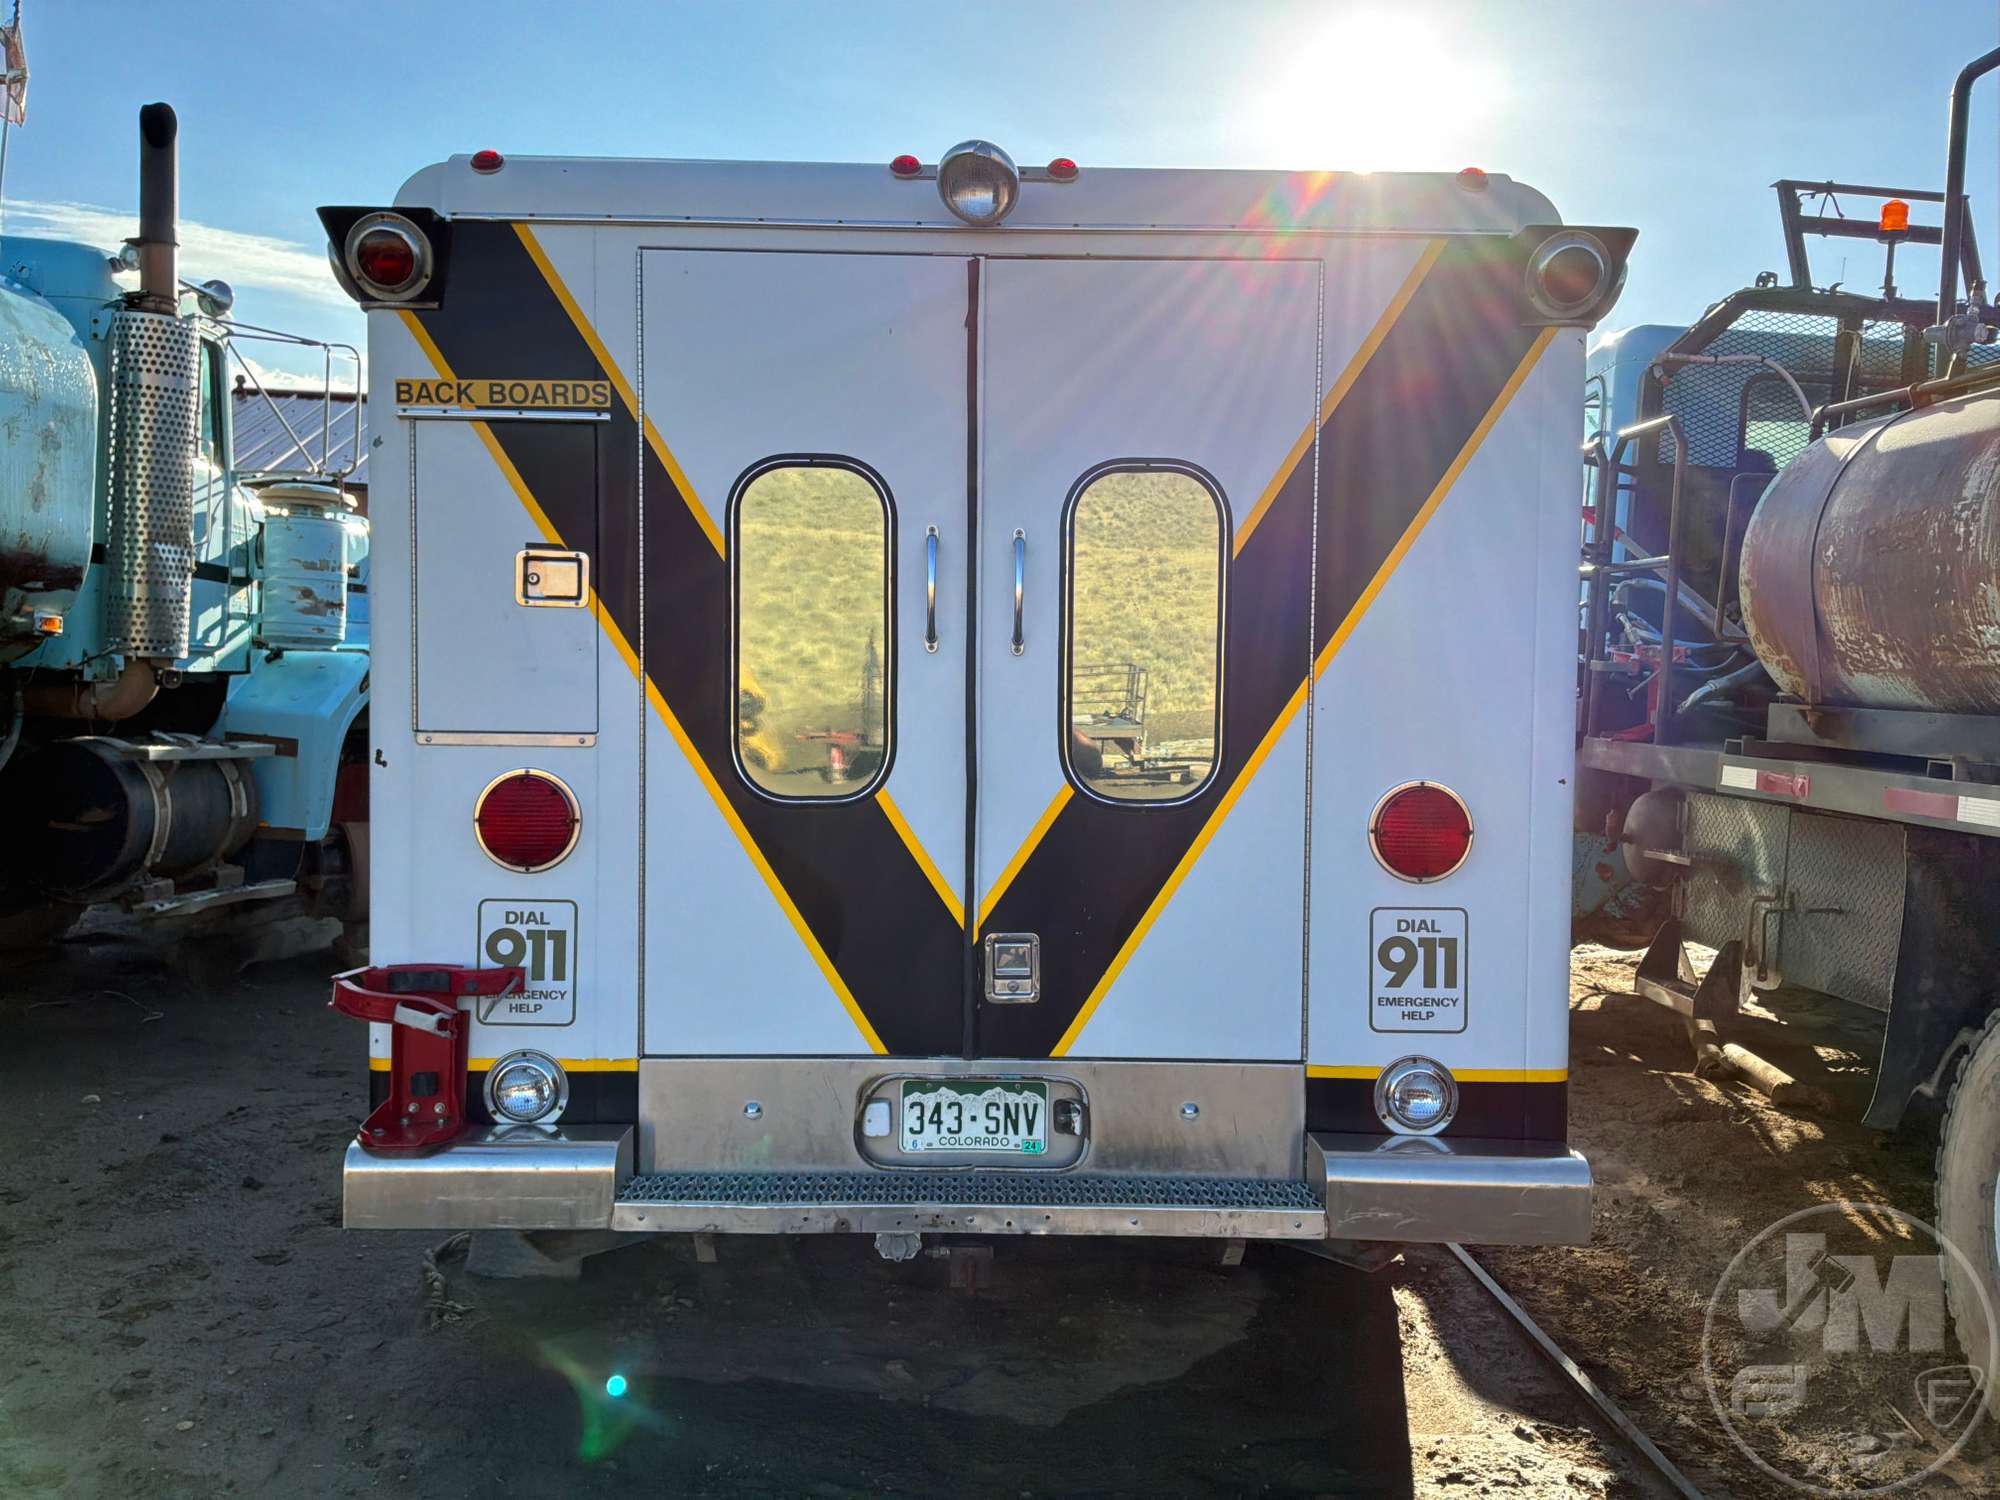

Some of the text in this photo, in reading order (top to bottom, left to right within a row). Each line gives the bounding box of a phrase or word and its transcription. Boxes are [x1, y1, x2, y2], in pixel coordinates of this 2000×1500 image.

[395, 382, 609, 405] BACK BOARDS
[505, 911, 550, 925] DIAL
[1397, 919, 1441, 933] DIAL
[486, 928, 567, 981] 911
[1378, 936, 1458, 989] 911
[486, 990, 568, 1001] ERGENCY
[1378, 997, 1459, 1007] EMERGENCY
[509, 1003, 543, 1013] HELP
[1402, 1011, 1435, 1021] HELP
[939, 1136, 1010, 1147] COLORADO
[1025, 1141, 1037, 1150] 24
